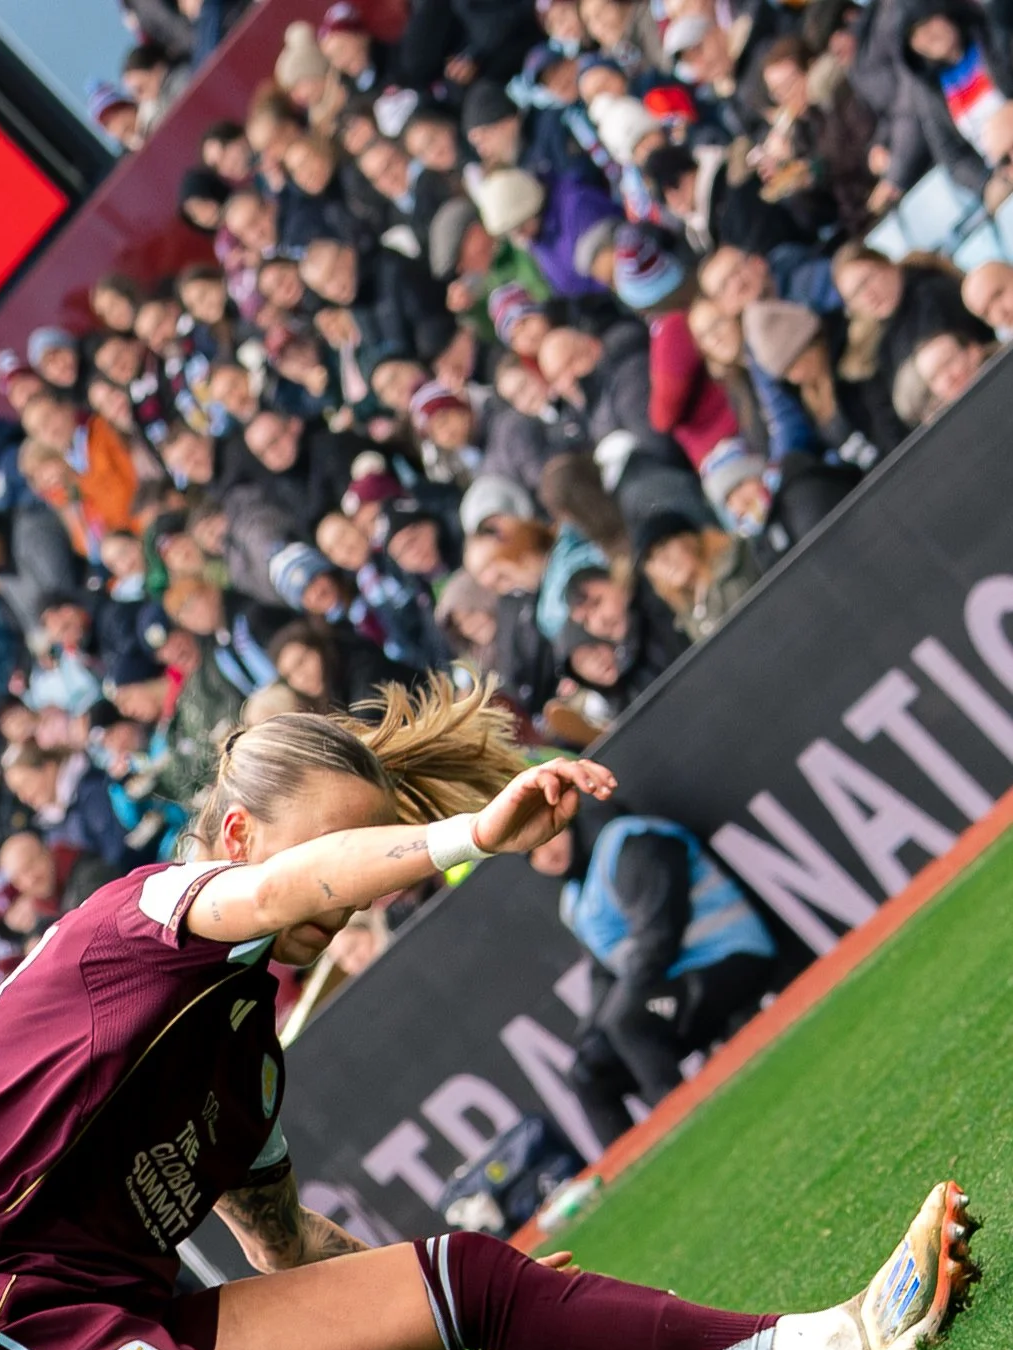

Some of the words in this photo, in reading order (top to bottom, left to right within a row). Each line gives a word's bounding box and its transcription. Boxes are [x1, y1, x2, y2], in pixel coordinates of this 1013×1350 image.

[149, 1142, 202, 1218] GLOBAL
[175, 1120, 200, 1167] THE
[133, 1151, 189, 1237] SUMMIT
